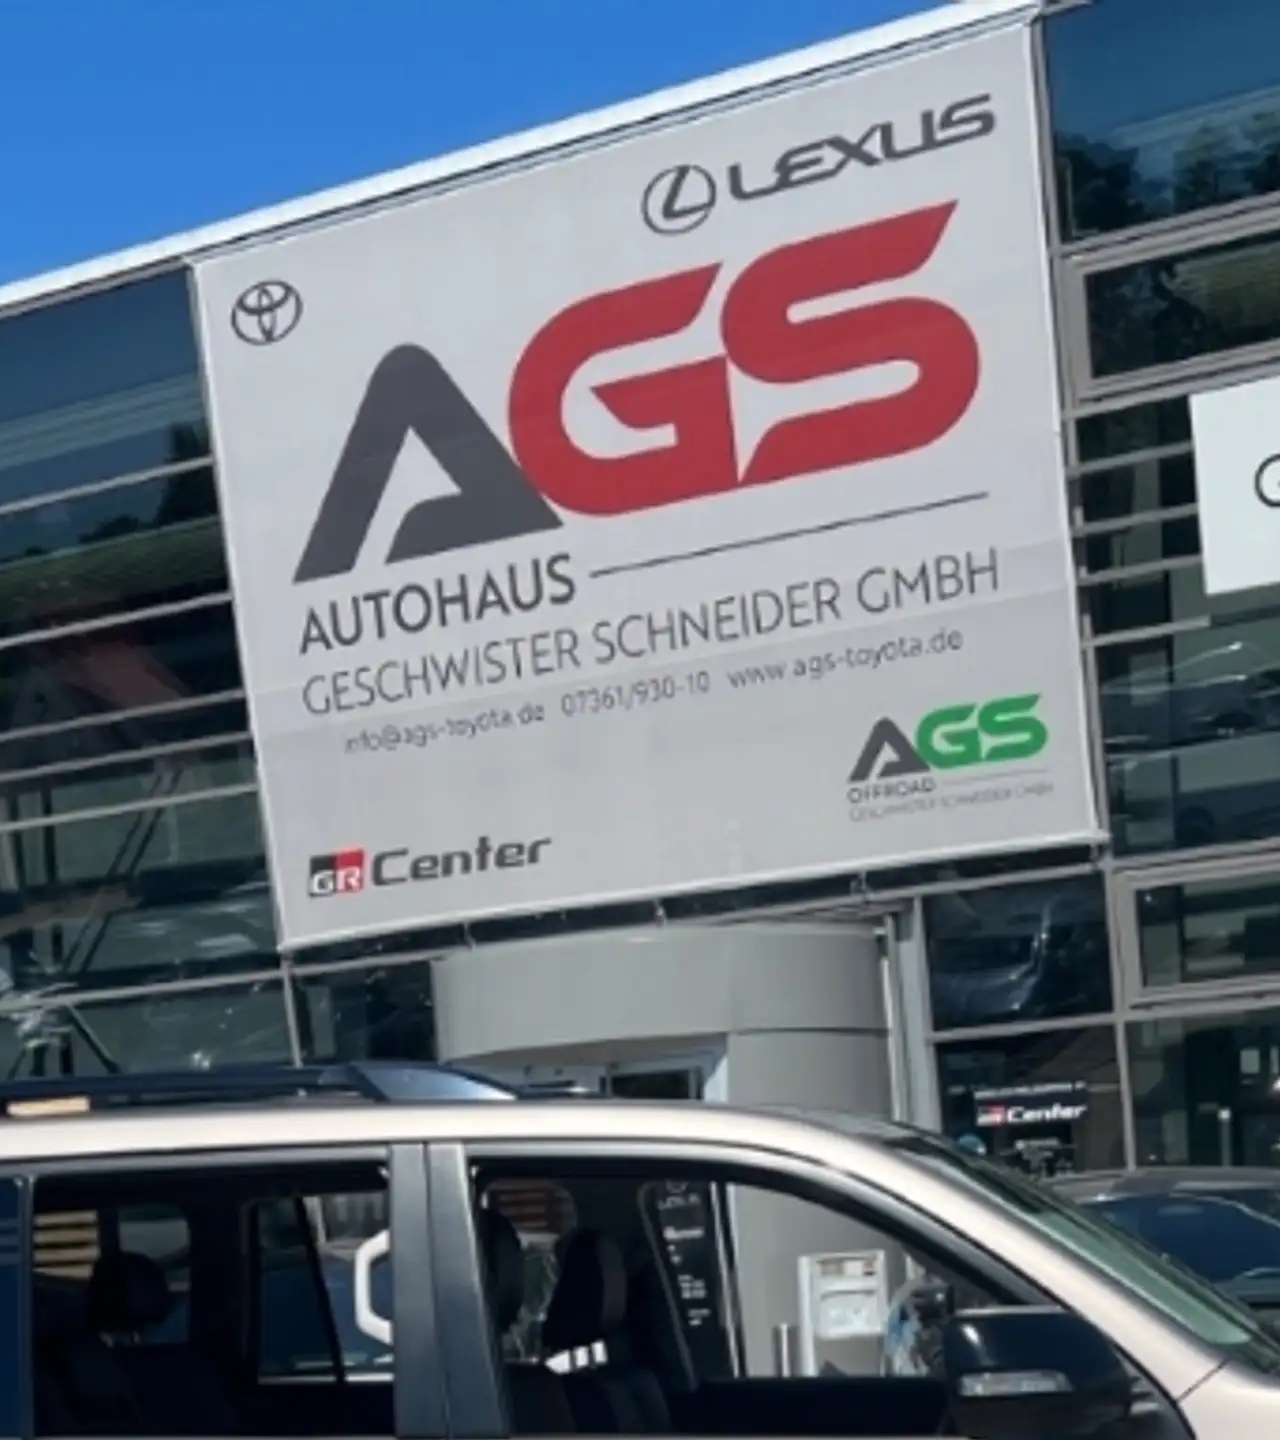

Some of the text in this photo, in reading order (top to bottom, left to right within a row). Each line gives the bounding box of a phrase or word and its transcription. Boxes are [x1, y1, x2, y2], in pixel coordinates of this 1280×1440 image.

[728, 94, 996, 201] LEXUS
[292, 199, 981, 584] AGS
[299, 553, 576, 656] AUTOHAUS
[302, 546, 1000, 716] GESCHWISTER SCHNEIDER GMBH
[344, 627, 964, 753] nfo@ags-toyotade 07361/930-10 wwwags-toyota.de
[847, 692, 1049, 783] AGS
[846, 777, 937, 805] OFFROAD
[309, 836, 553, 898] GR Center
